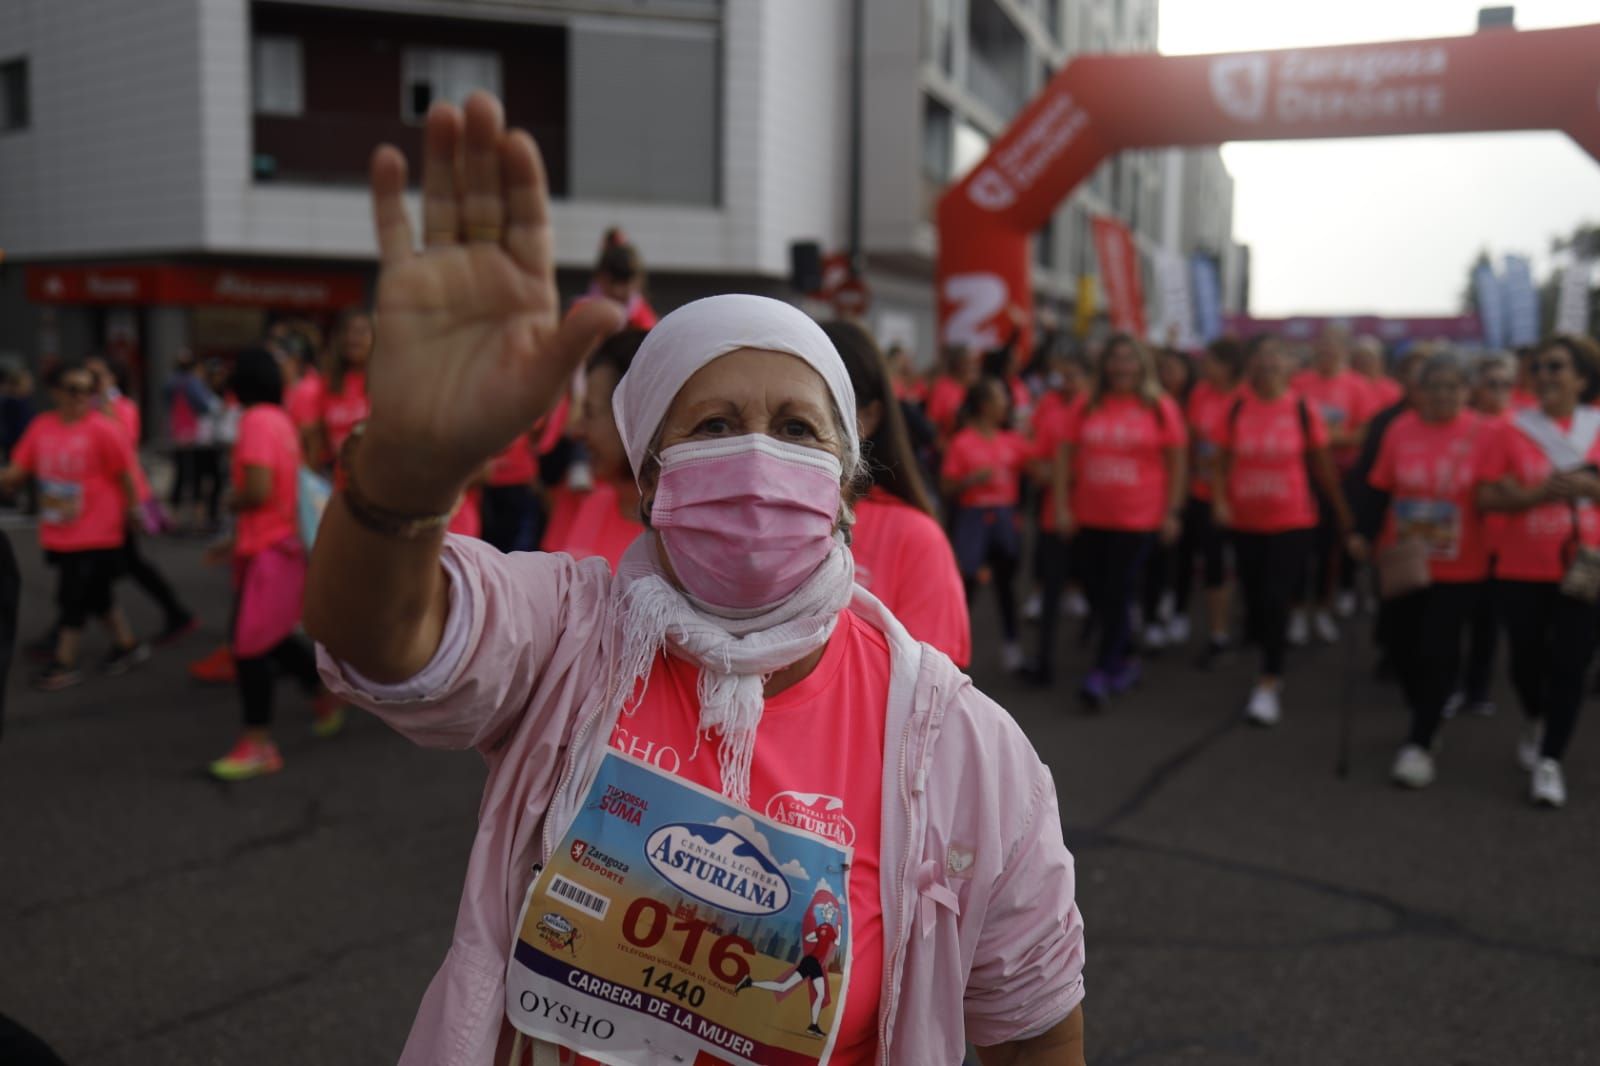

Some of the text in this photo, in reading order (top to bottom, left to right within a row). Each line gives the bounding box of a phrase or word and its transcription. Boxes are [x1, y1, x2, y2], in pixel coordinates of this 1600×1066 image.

[600, 795, 642, 827] SUMA
[617, 790, 648, 811] DORSAL
[581, 857, 625, 885] DEPORTE
[587, 846, 630, 873] Zaragoza
[651, 834, 776, 910] ASTURIANA
[681, 839, 779, 888] CENTRAL LECHERA
[622, 897, 756, 985] 016
[642, 966, 706, 1008] 1440
[520, 990, 615, 1040] OYSHO
[568, 970, 641, 1009] CARRERA
[648, 997, 670, 1018] DE
[673, 1008, 693, 1030] LA
[698, 1020, 754, 1057] MUJER
